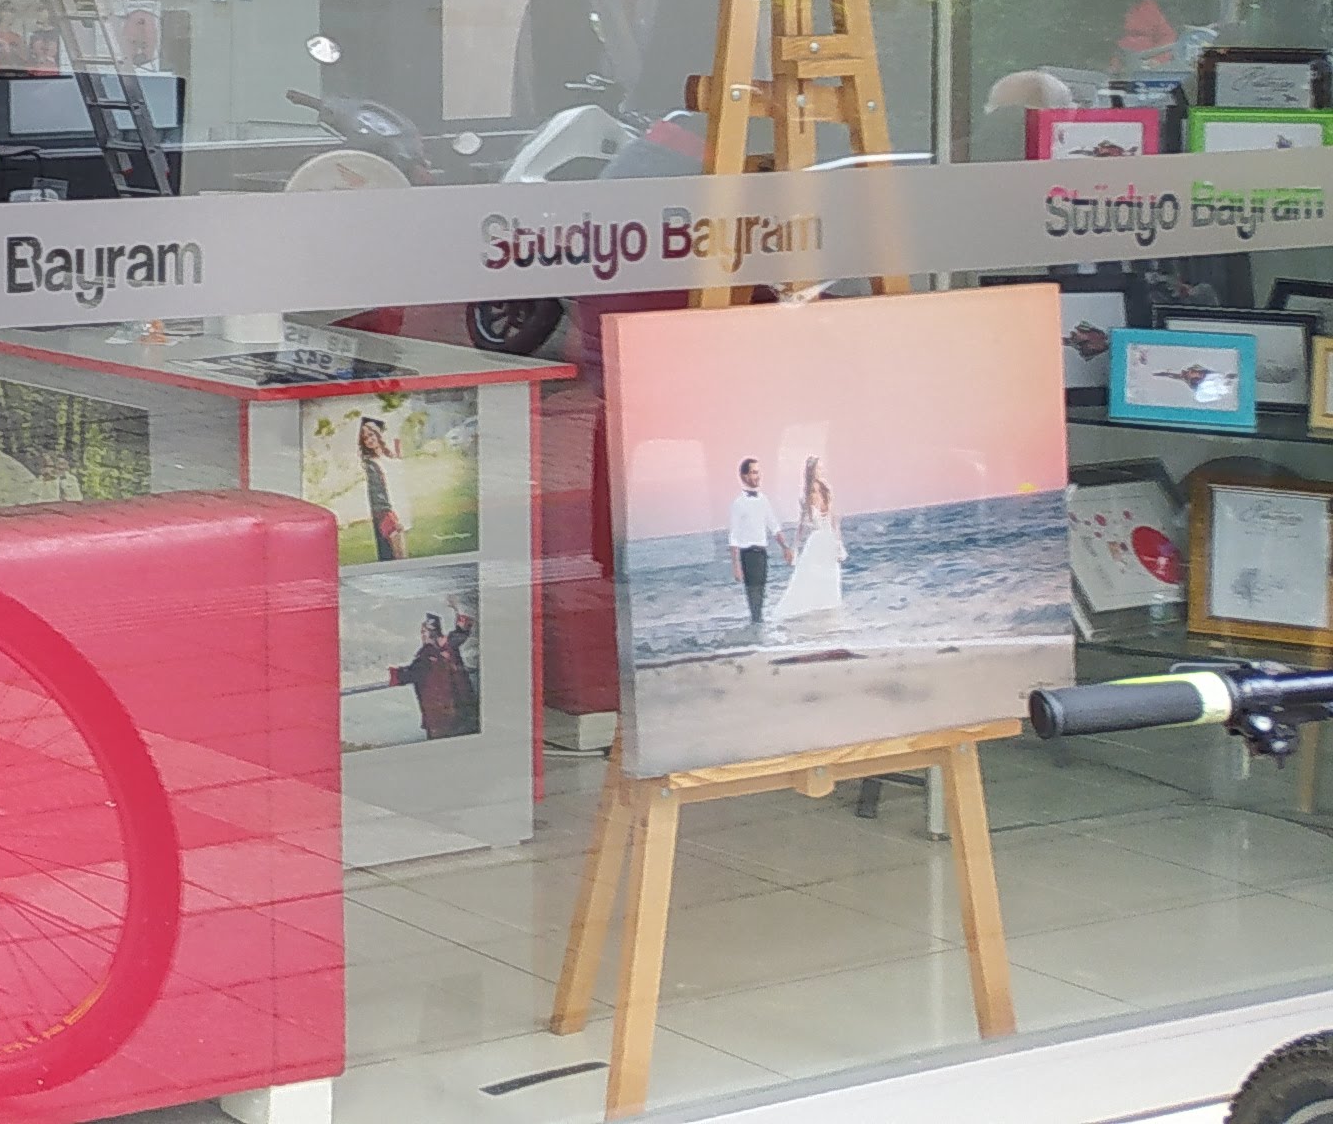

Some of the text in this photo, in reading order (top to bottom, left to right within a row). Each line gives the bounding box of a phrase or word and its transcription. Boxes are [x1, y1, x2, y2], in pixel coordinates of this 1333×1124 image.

[480, 206, 824, 280] Stüdyo Bayram
[1045, 180, 1326, 247] Stüdyo Bayram
[5, 232, 206, 309] Bayram
